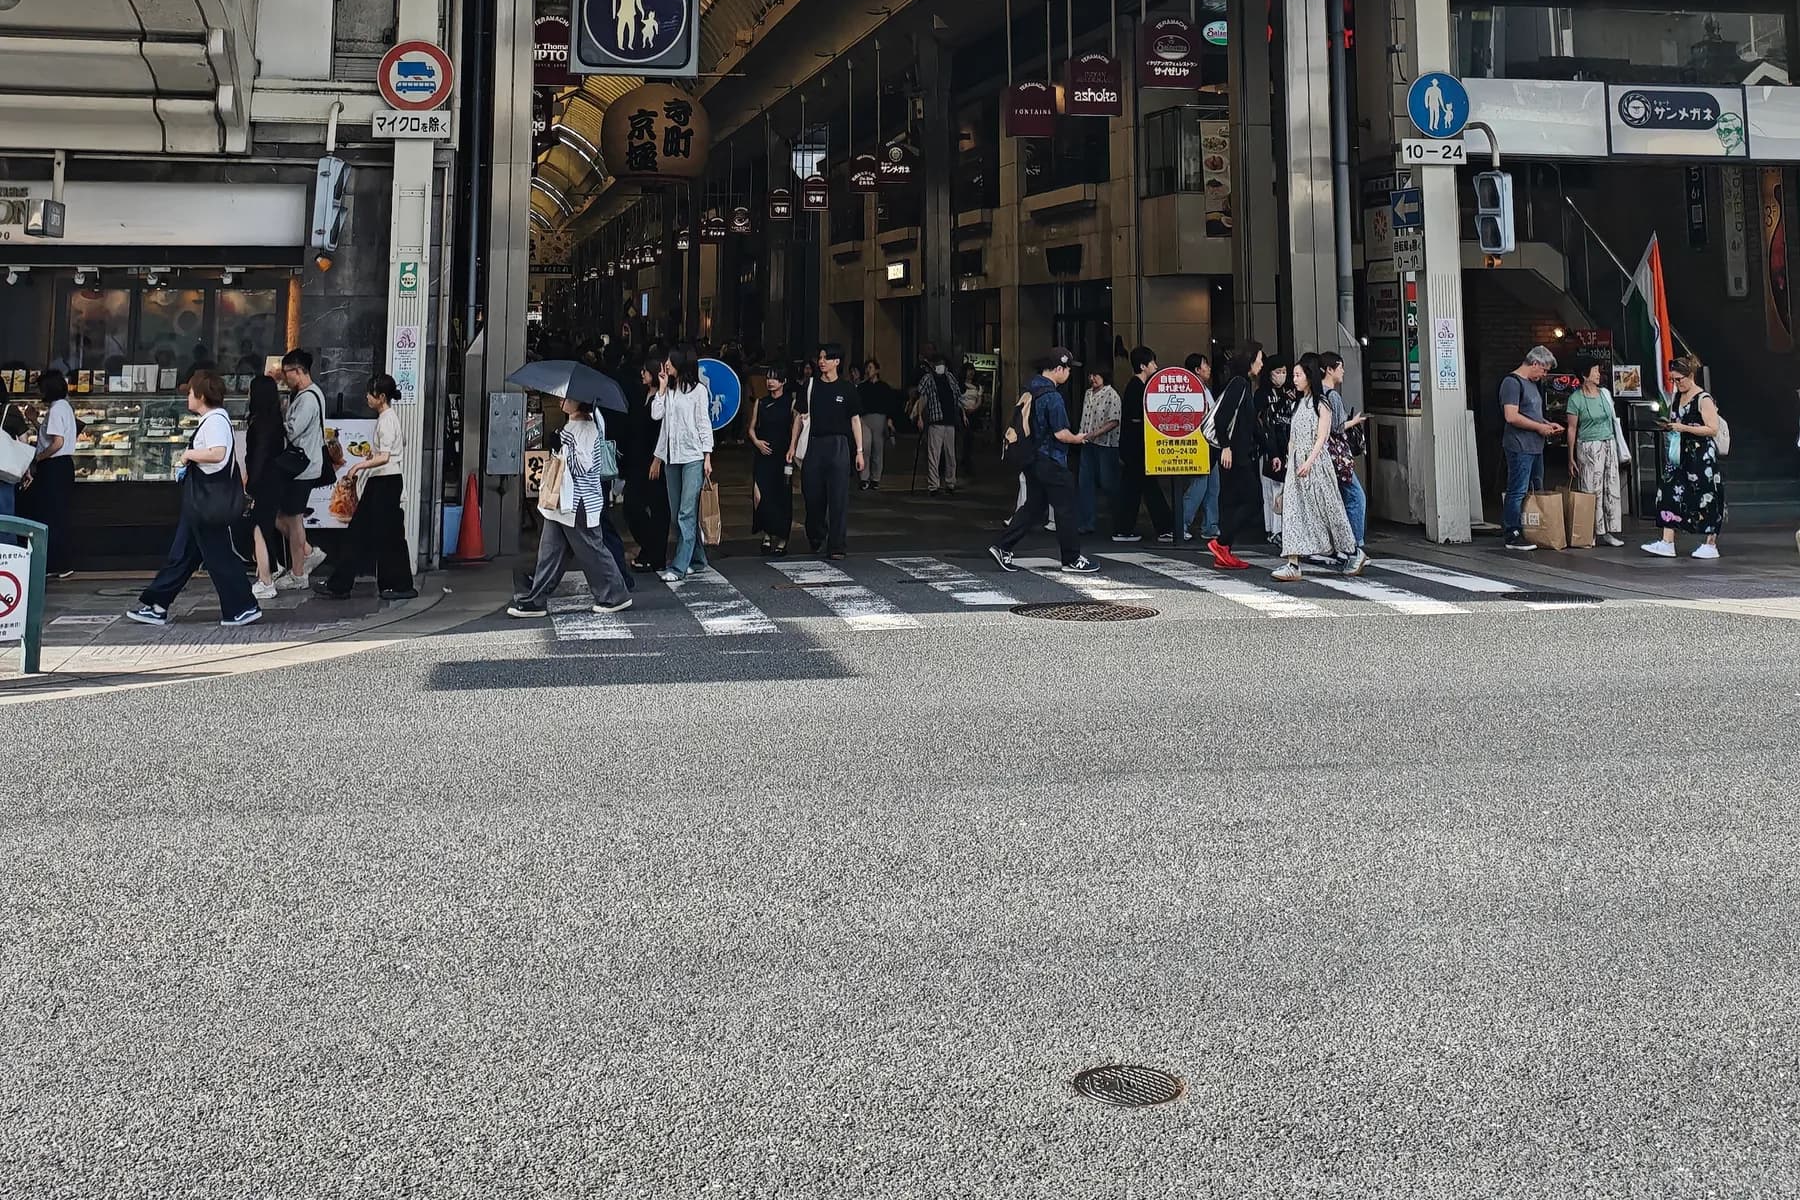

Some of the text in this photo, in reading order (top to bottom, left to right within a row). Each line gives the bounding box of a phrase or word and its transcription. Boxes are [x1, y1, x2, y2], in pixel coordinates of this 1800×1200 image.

[542, 42, 569, 50] Thoma
[533, 49, 569, 61] IPTO
[1154, 67, 1190, 76] サイゼリヤ
[1074, 88, 1117, 103] ashoka
[1654, 106, 1715, 120] サンメガネ
[376, 116, 447, 133] マイクロを除く
[1160, 375, 1190, 384] 自転車も
